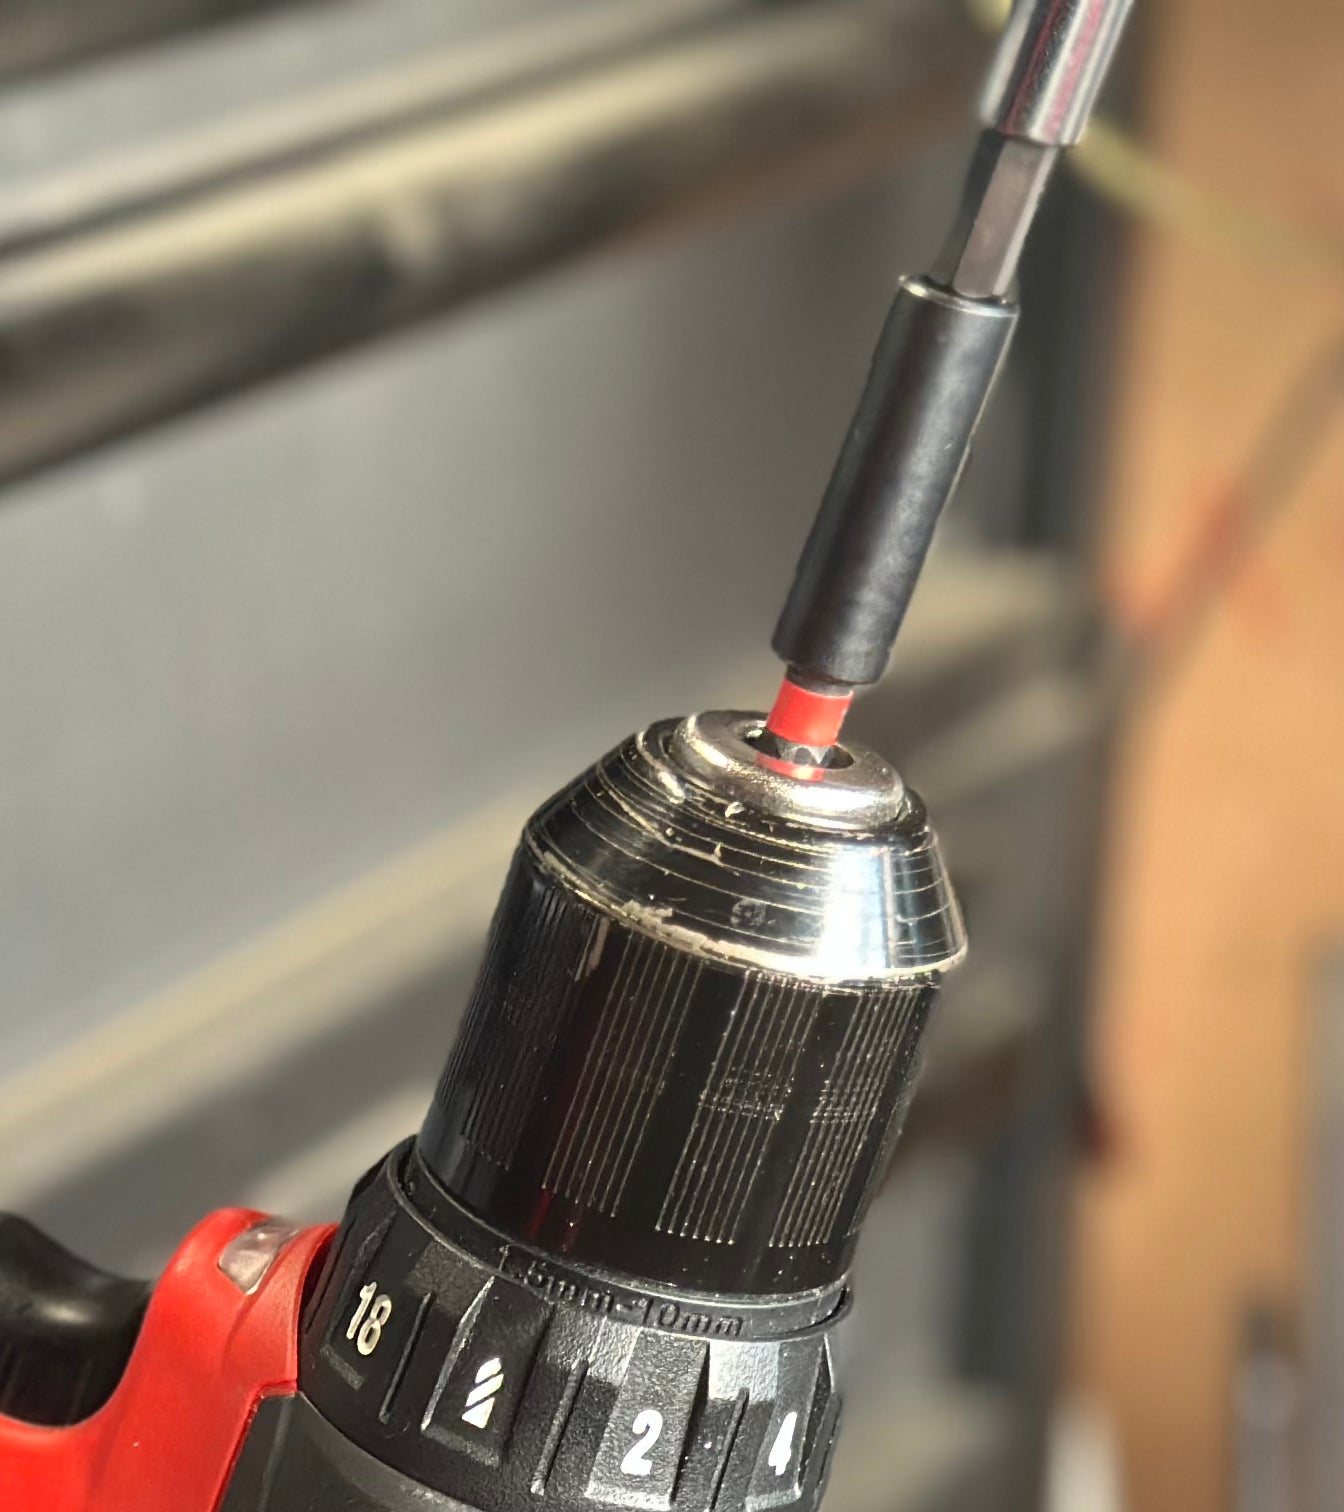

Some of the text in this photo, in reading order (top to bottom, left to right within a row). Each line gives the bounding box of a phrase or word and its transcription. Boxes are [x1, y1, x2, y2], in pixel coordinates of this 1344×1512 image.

[345, 1280, 394, 1358] 18
[619, 1408, 664, 1478] 2
[767, 1410, 800, 1478] 4
